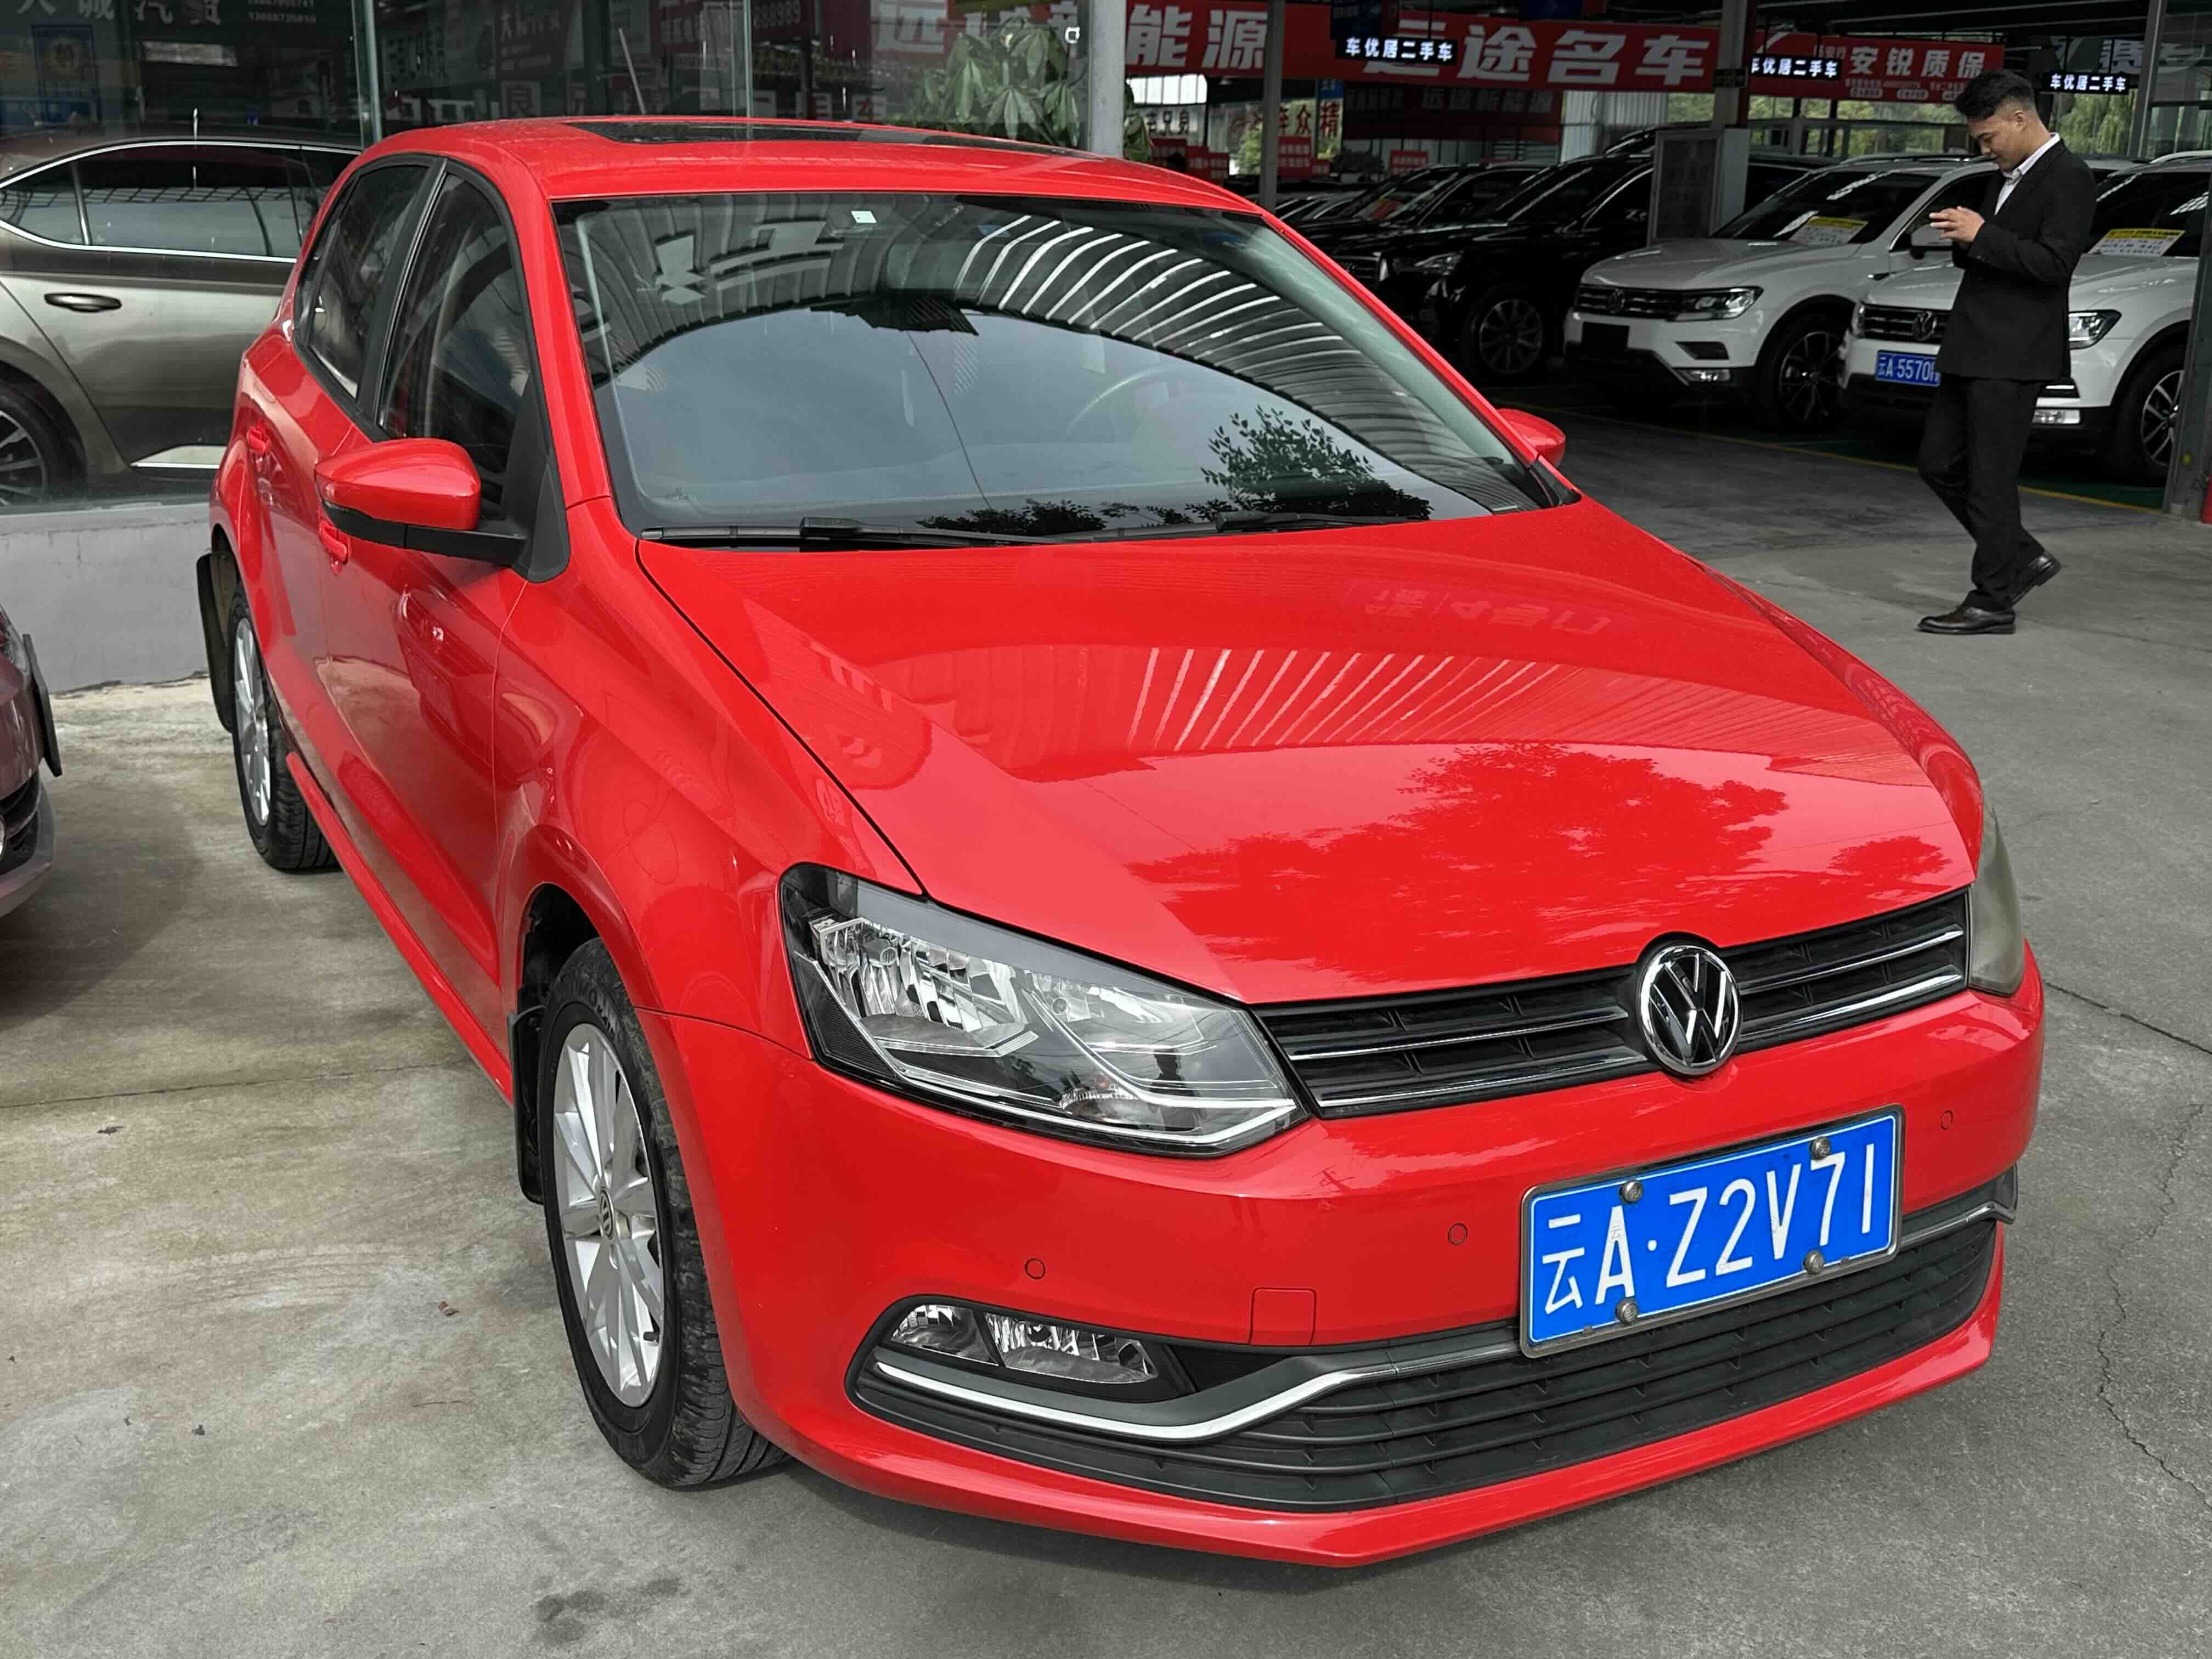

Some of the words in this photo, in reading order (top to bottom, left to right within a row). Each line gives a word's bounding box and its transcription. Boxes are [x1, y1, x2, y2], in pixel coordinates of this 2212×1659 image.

[1346, 37, 1453, 62] 车优居二手车
[1849, 45, 1985, 78] 安锐质保
[2050, 74, 2127, 92] 车优居二手车
[1542, 1143, 1875, 1315] 云A·Z2V71
